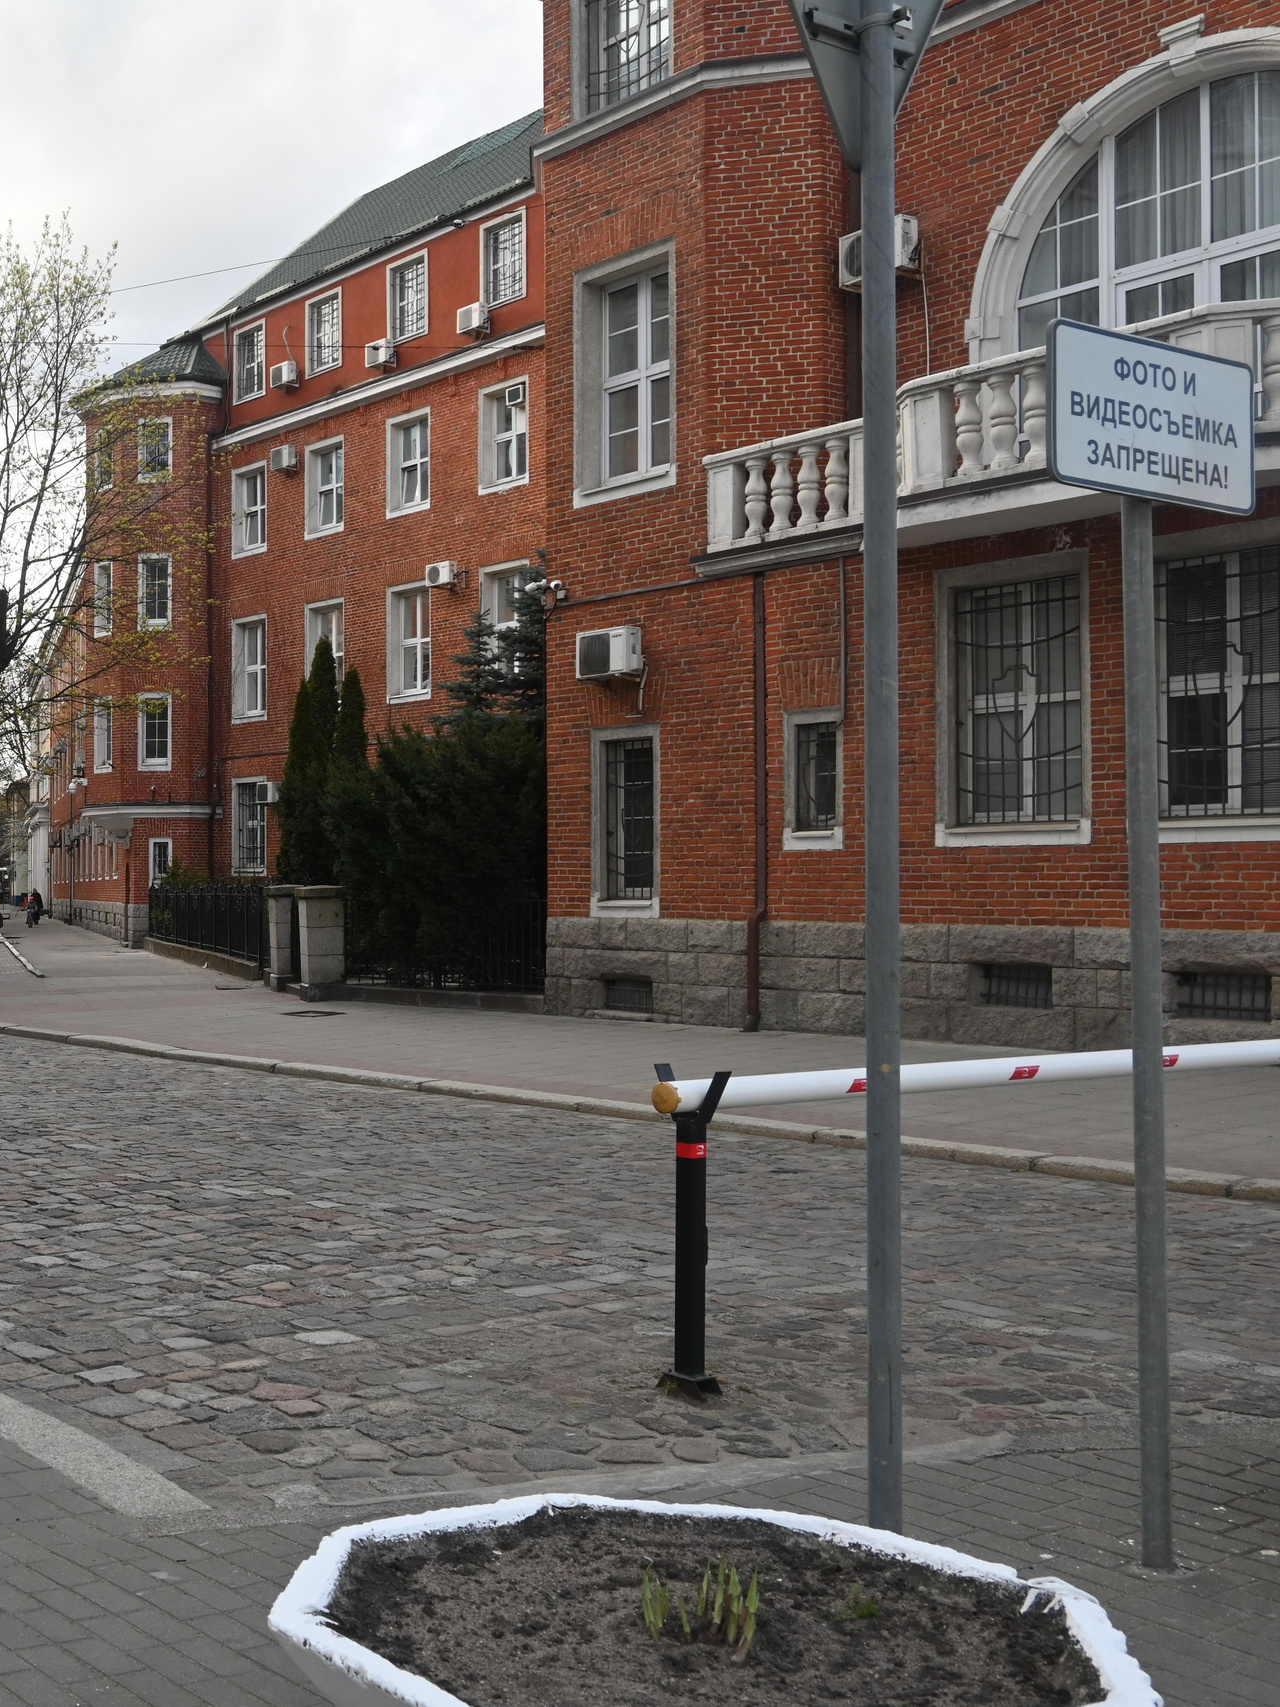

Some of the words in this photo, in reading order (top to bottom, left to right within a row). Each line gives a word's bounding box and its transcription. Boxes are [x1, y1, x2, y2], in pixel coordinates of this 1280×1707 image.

[1114, 357, 1176, 391] ФОТО
[1183, 371, 1196, 396] И
[1070, 391, 1238, 448] ВИДЕОСЪЕМКА
[1087, 439, 1228, 489] ЗАПРЕЩЕНА!
